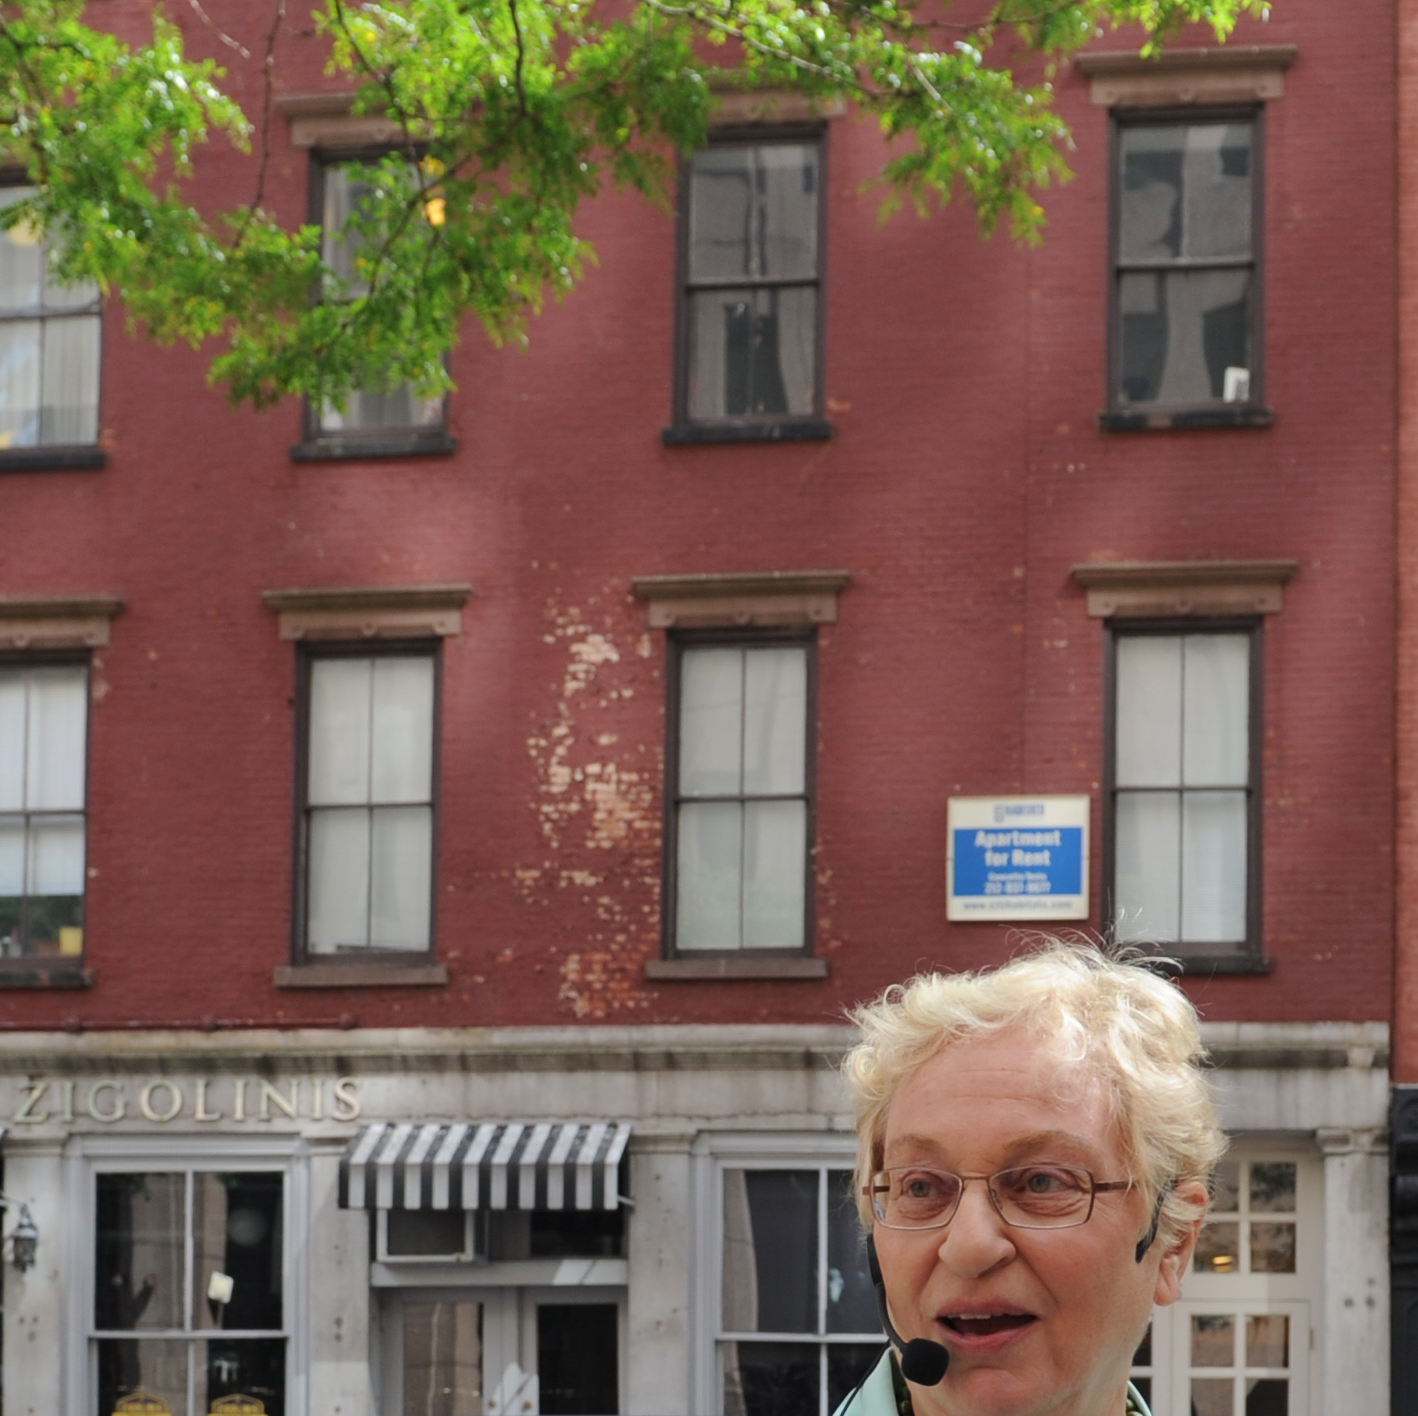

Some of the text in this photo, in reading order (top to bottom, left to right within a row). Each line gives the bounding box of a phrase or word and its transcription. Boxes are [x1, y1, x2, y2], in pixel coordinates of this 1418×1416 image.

[975, 830, 1061, 849] Apartment
[985, 849, 1051, 866] for Rent
[14, 1077, 362, 1123] ZIGOLINIS
